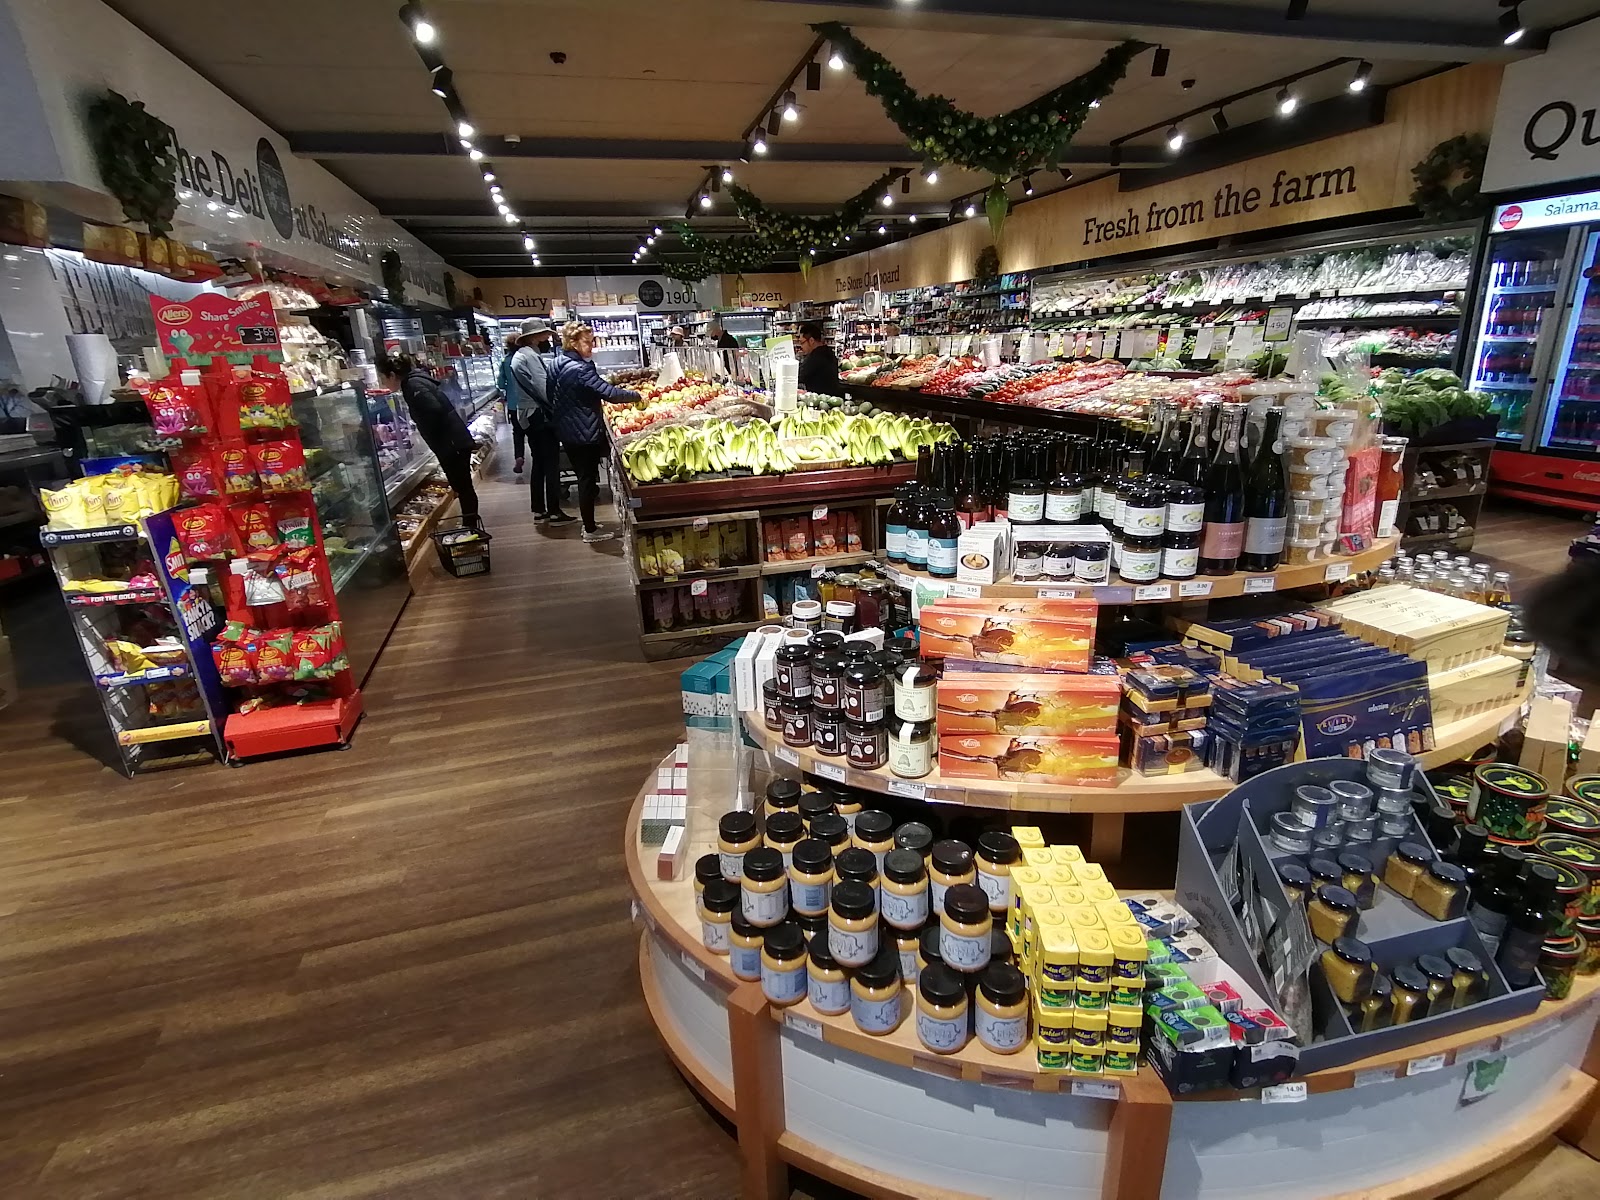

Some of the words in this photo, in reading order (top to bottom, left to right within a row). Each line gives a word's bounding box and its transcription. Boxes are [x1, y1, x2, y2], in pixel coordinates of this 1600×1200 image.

[168, 125, 214, 197] he
[212, 150, 265, 220] Deli
[1083, 209, 1140, 245] Fresh
[1146, 200, 1204, 233] from
[1214, 184, 1261, 218] the
[1269, 165, 1357, 207] farm
[836, 278, 847, 293] The
[847, 276, 863, 290] Store
[504, 295, 548, 310] Dairy
[666, 290, 698, 305] 1901
[200, 311, 229, 321] Share
[228, 300, 261, 318] Smiles
[92, 530, 120, 538] CURIOSITY
[91, 595, 104, 603] FOR
